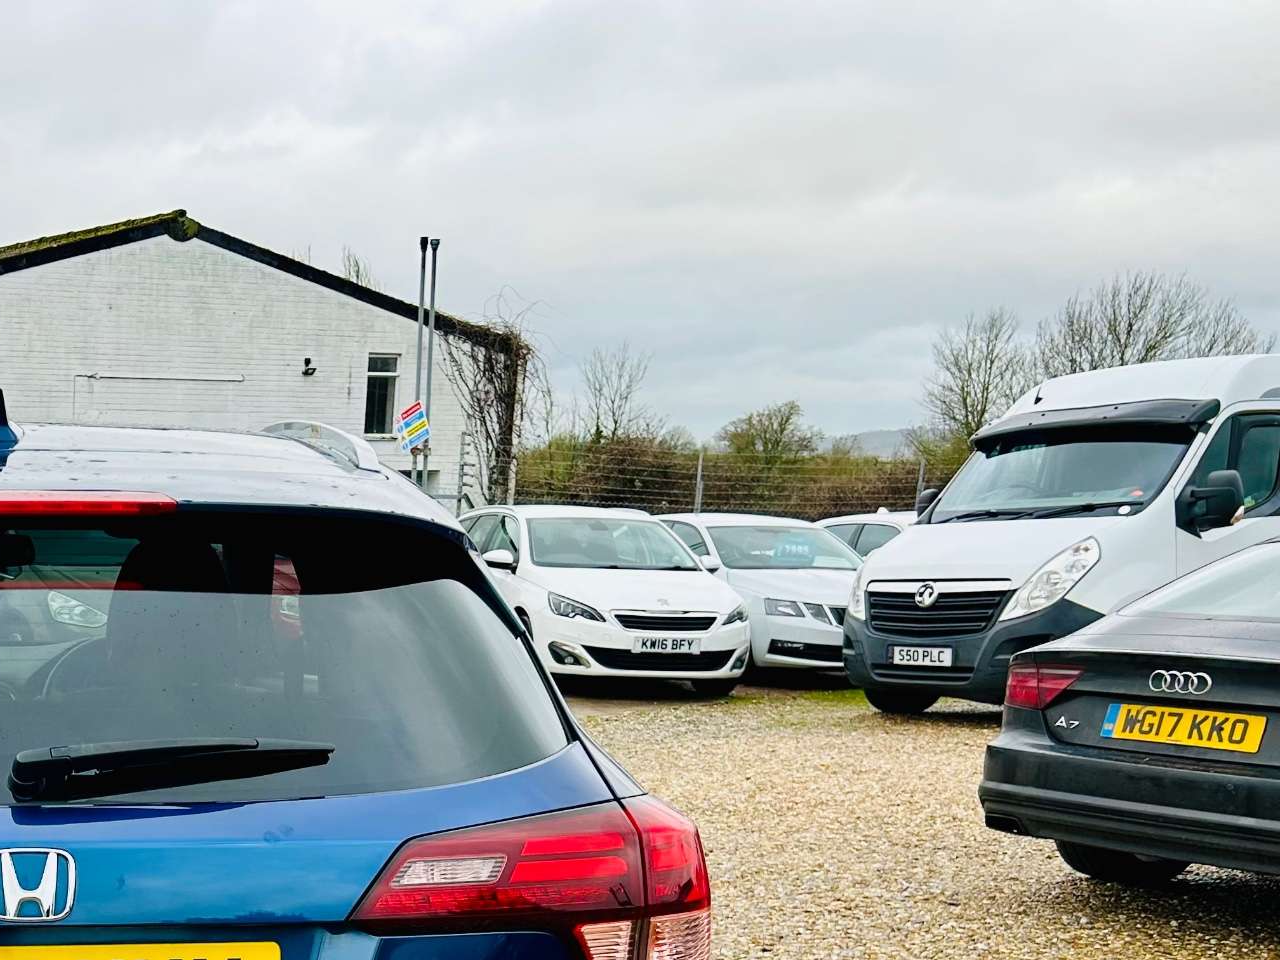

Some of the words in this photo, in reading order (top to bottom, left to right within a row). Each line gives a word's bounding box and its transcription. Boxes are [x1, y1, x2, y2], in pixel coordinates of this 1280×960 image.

[671, 639, 694, 650] BFY
[922, 650, 945, 663] PLC
[1054, 715, 1080, 729] A7
